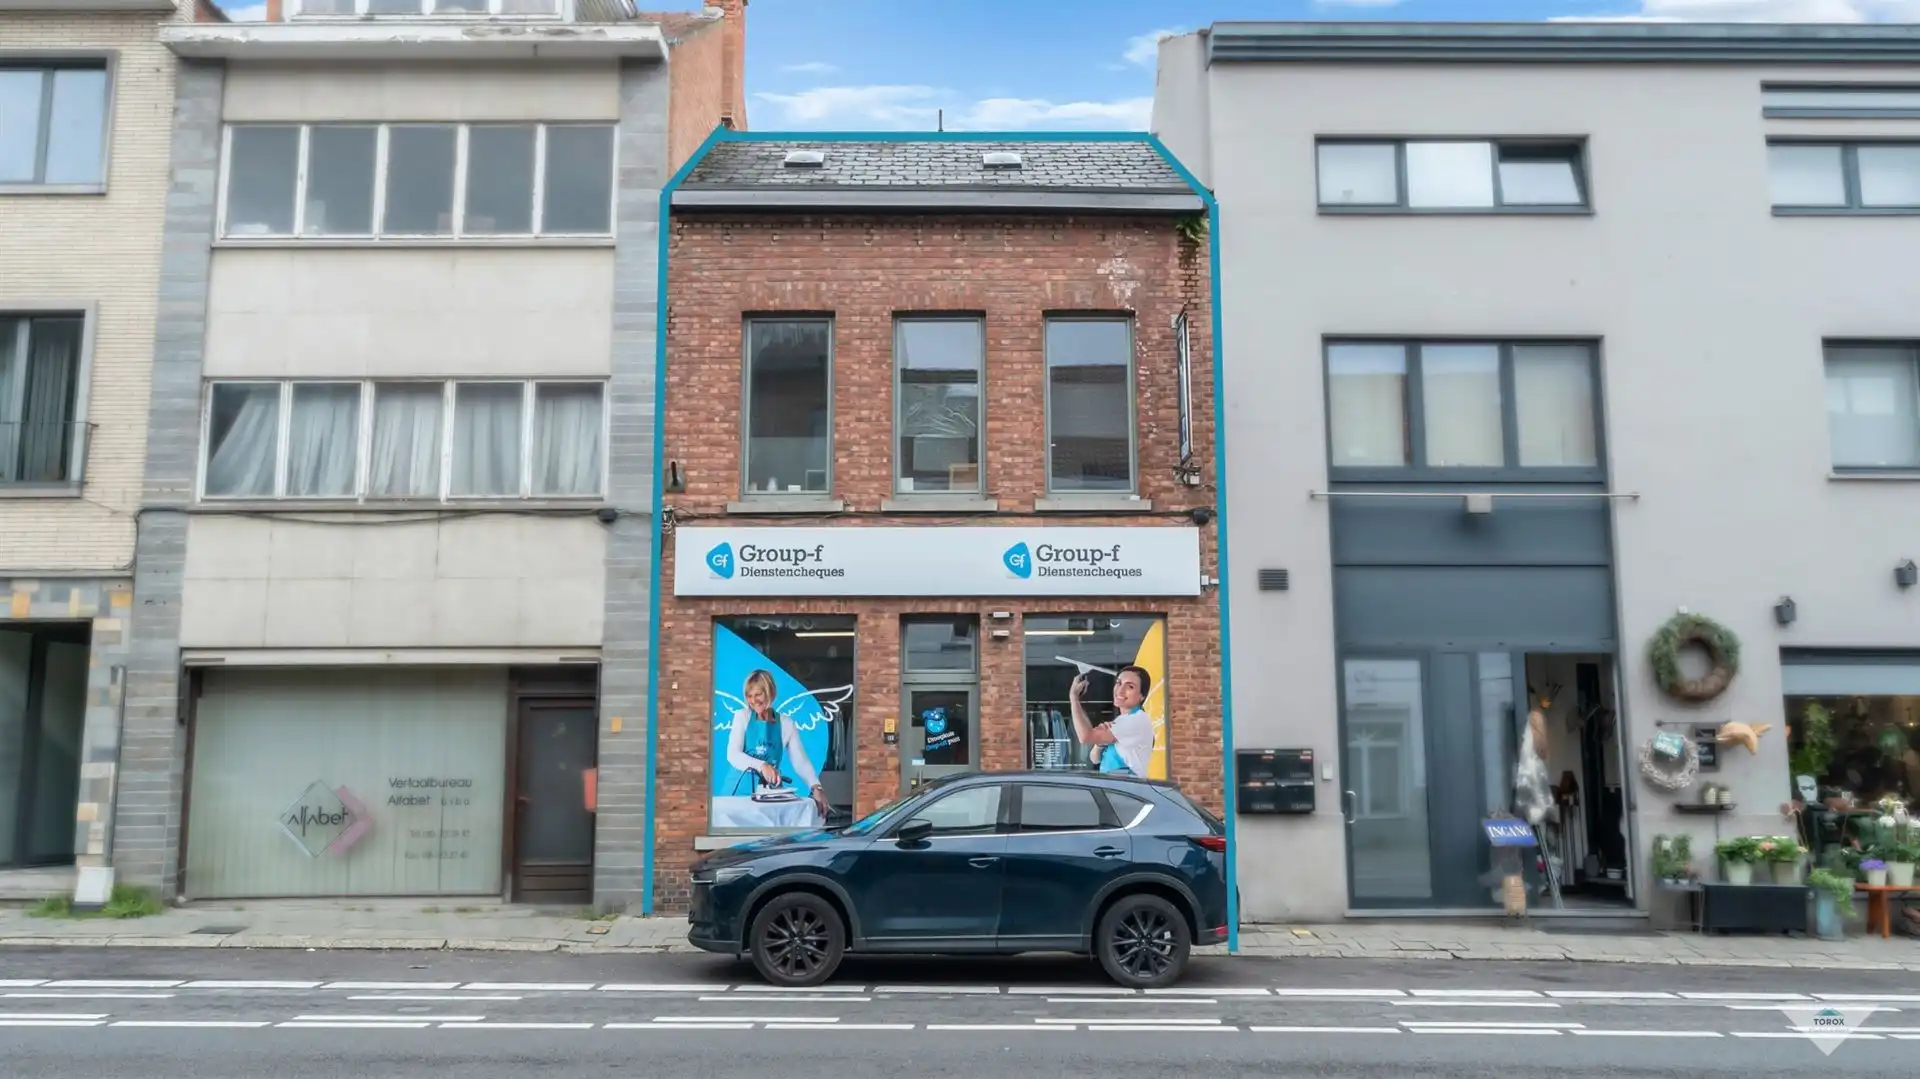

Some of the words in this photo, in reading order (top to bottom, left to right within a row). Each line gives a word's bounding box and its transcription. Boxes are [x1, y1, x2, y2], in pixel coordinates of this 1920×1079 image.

[739, 544, 824, 565] Group-f
[1036, 544, 1120, 565] Group-f
[740, 566, 845, 579] Dienstencheques
[1038, 566, 1142, 579] Dienstencheques
[388, 777, 472, 788] Vertaalbureau
[387, 795, 431, 806] Alfabet
